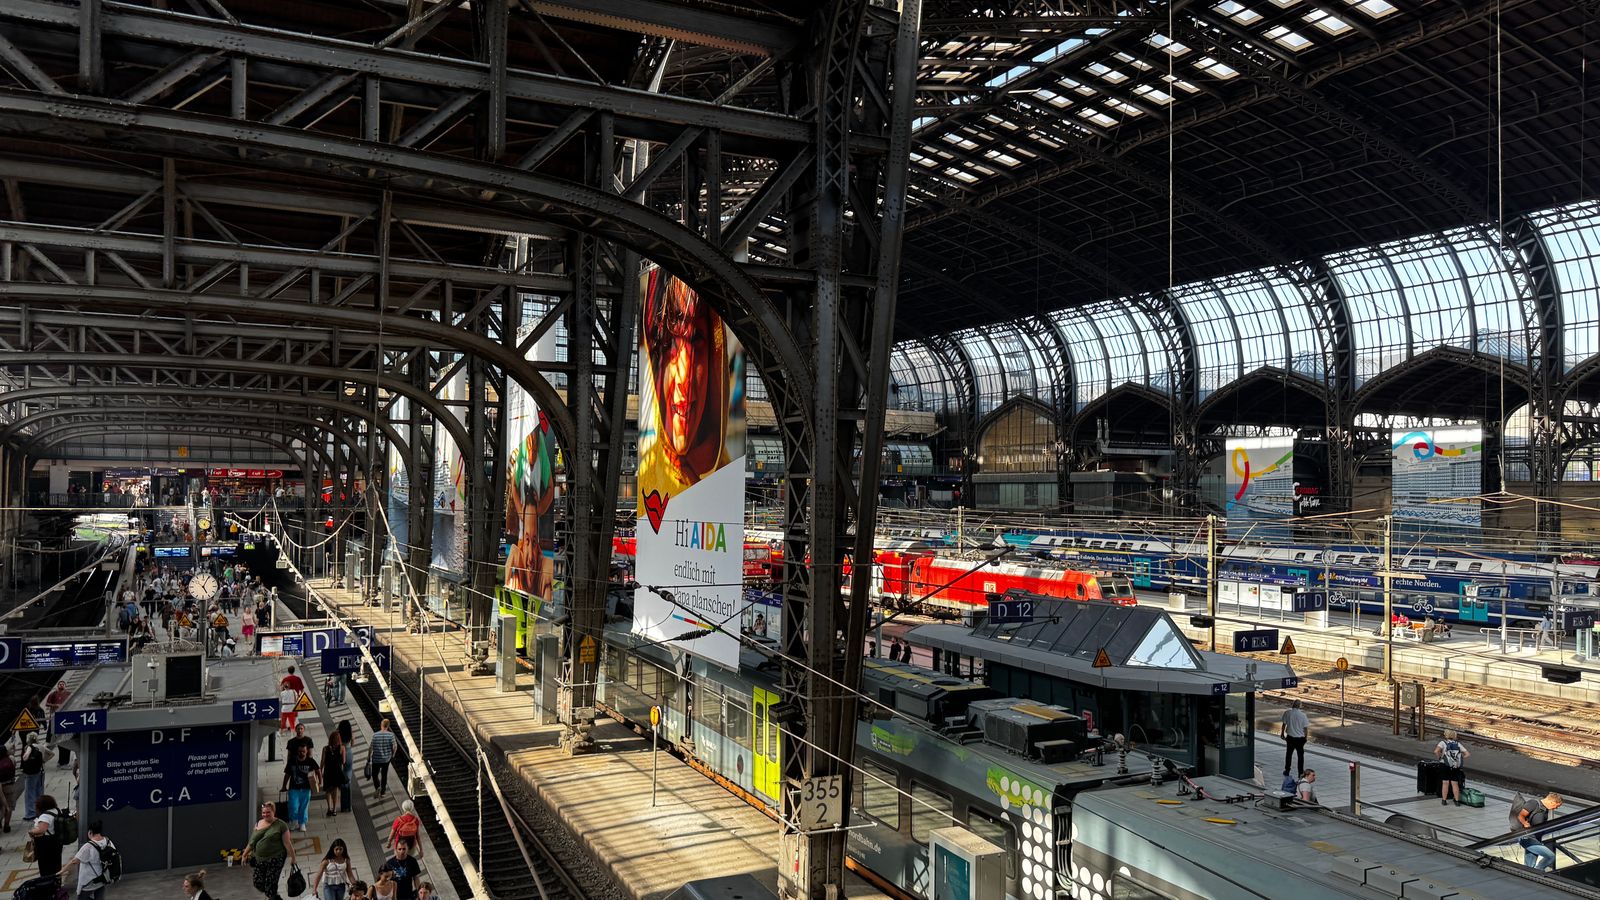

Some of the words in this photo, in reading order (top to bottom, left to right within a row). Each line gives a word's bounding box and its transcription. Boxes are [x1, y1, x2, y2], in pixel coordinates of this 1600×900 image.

[675, 519, 688, 547] Hi
[690, 521, 727, 553] AIDA
[674, 560, 700, 582] endlich
[702, 565, 716, 584] mit
[1414, 579, 1442, 588] Norden.
[692, 590, 736, 617] planschen!
[1297, 595, 1306, 608] 11
[1315, 594, 1322, 607] D
[997, 603, 1008, 618] D
[1016, 602, 1031, 617] 12
[312, 631, 331, 654] D
[241, 702, 257, 715] 13
[80, 711, 97, 725] 14
[151, 730, 164, 744] D
[180, 728, 192, 743] F
[122, 758, 149, 767] verteilen
[149, 757, 160, 765] Sie
[190, 761, 207, 769] entire
[207, 760, 226, 768] length
[102, 774, 132, 784] gesamten
[133, 771, 163, 781] Bahnsteig
[113, 767, 127, 775] sich
[138, 765, 153, 773] dem
[204, 766, 229, 775] platform
[150, 788, 163, 804] C
[178, 786, 192, 802] A
[804, 777, 840, 802] 355
[816, 803, 827, 824] 2
